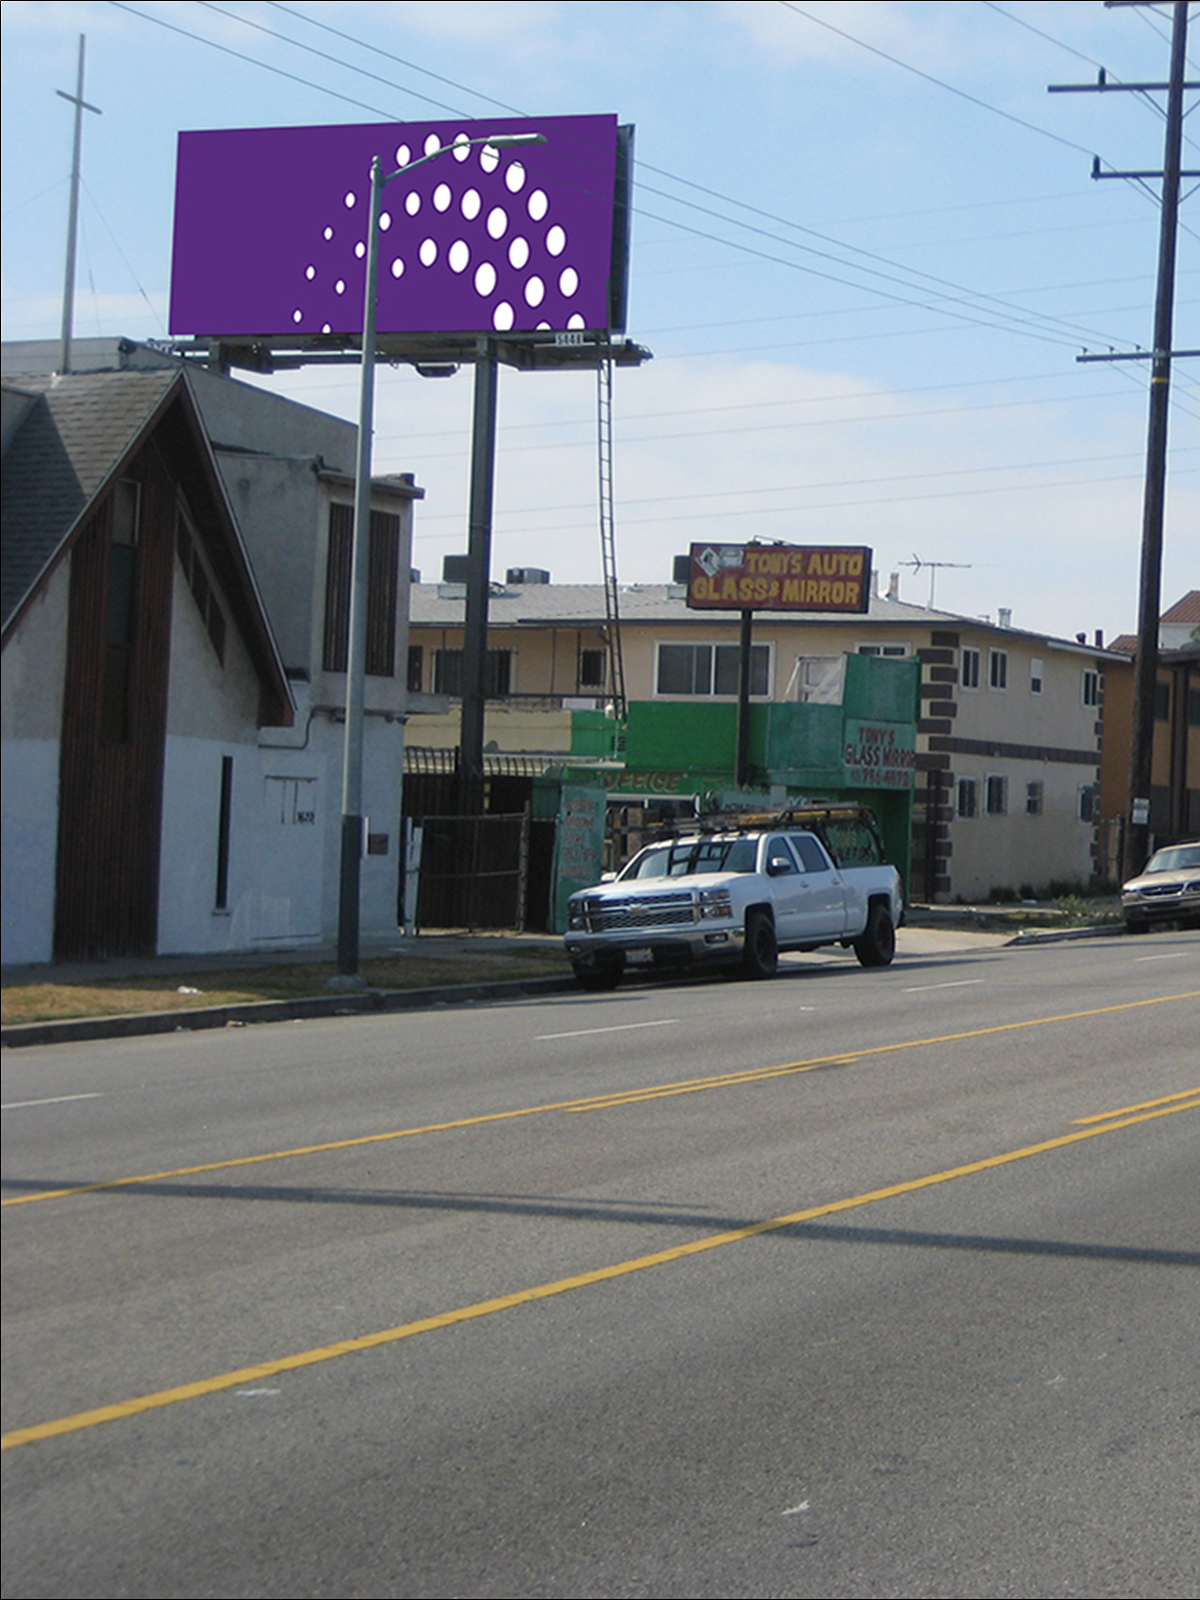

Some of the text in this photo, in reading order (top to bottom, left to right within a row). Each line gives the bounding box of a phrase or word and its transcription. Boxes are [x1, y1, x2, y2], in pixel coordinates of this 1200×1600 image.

[746, 552, 864, 577] TONY'S AUTO
[692, 576, 860, 604] GLASS & MIRROR
[858, 726, 895, 746] TONY'S
[845, 743, 881, 767] GLASS
[601, 769, 681, 793] OFFICE
